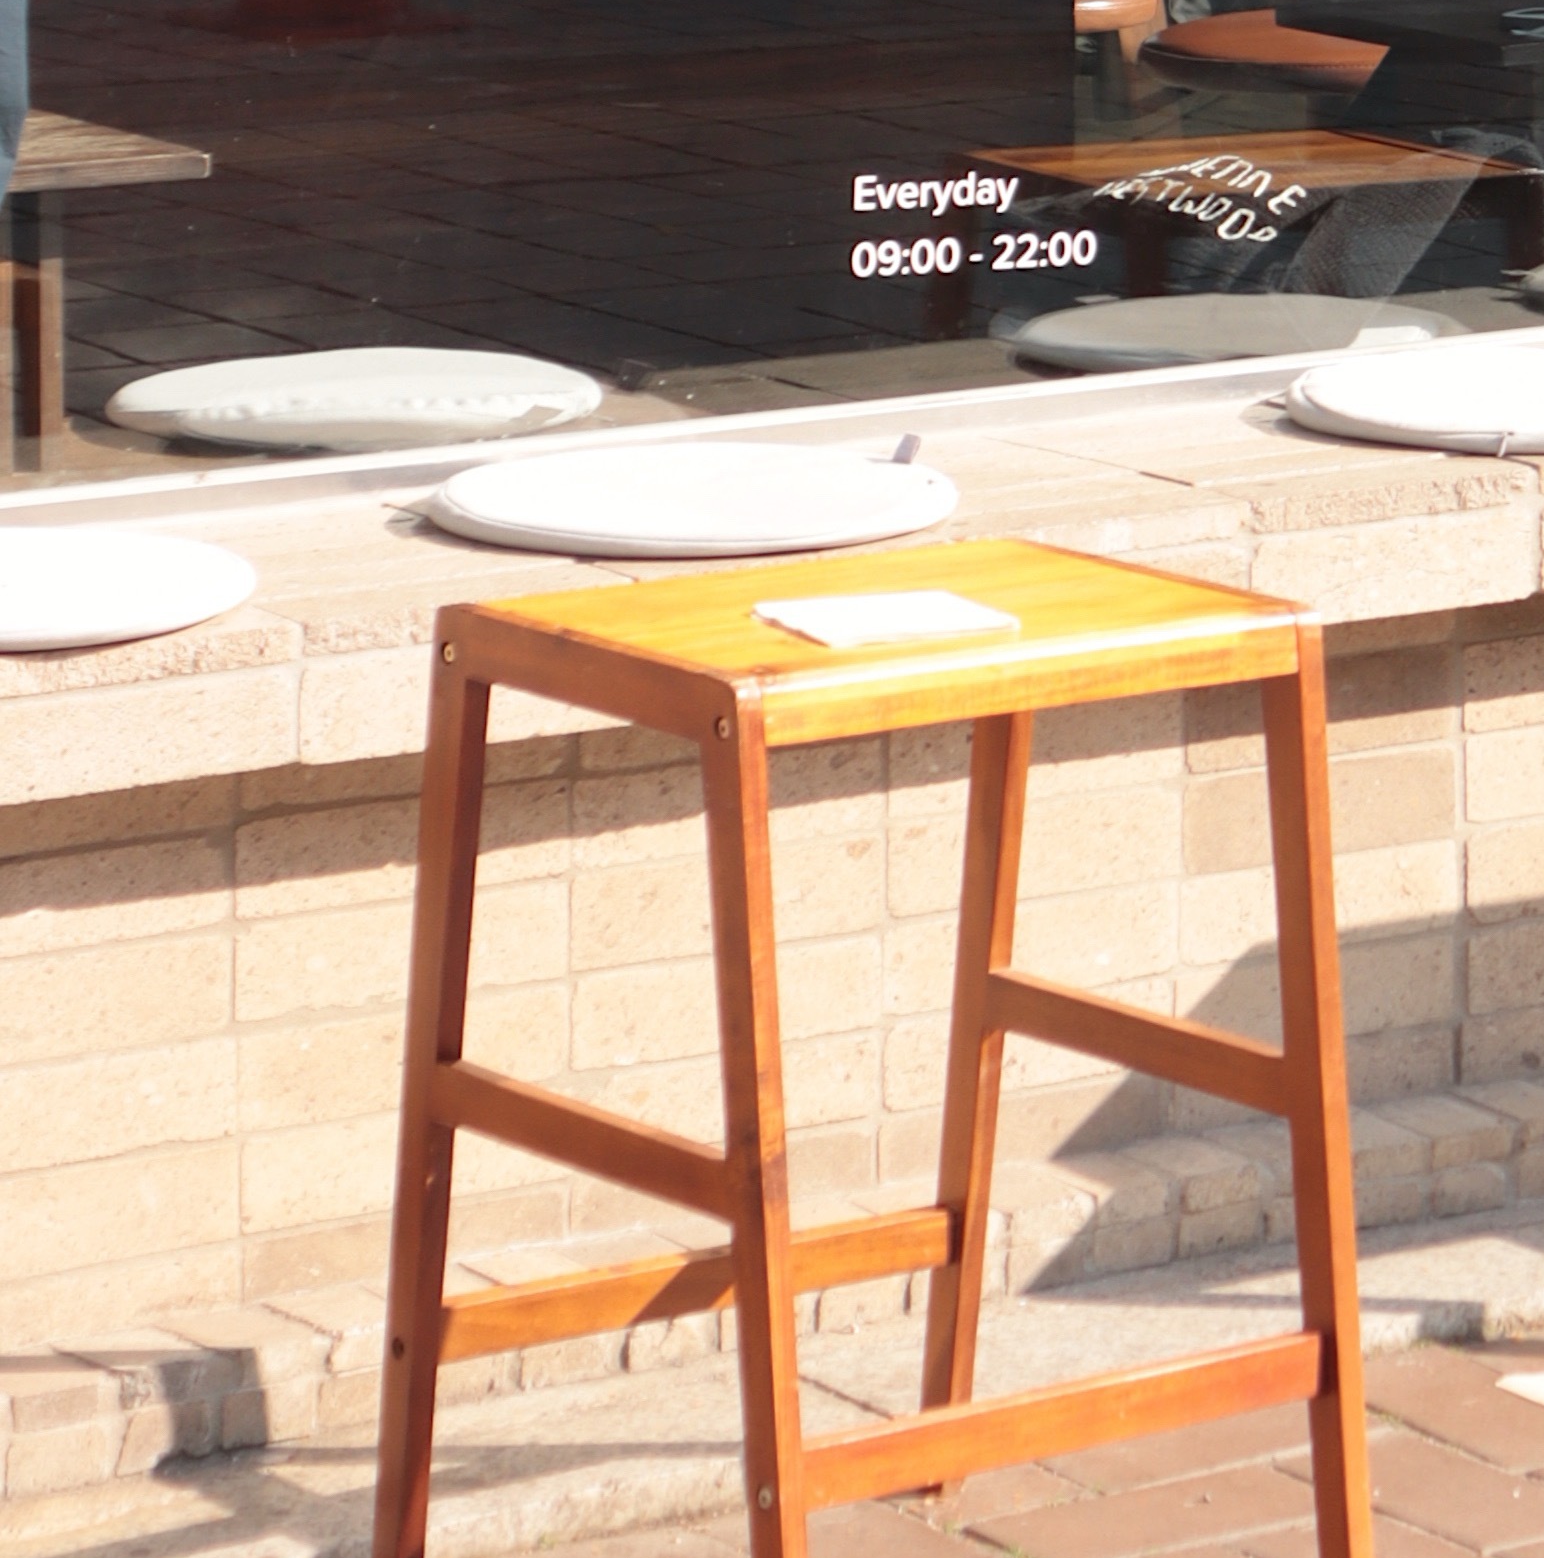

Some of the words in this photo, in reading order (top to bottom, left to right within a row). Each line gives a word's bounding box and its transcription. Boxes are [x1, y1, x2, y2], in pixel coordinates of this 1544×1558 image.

[852, 170, 1020, 215] Everyday
[851, 236, 961, 279] 09:00
[992, 228, 1098, 271] 22:00
